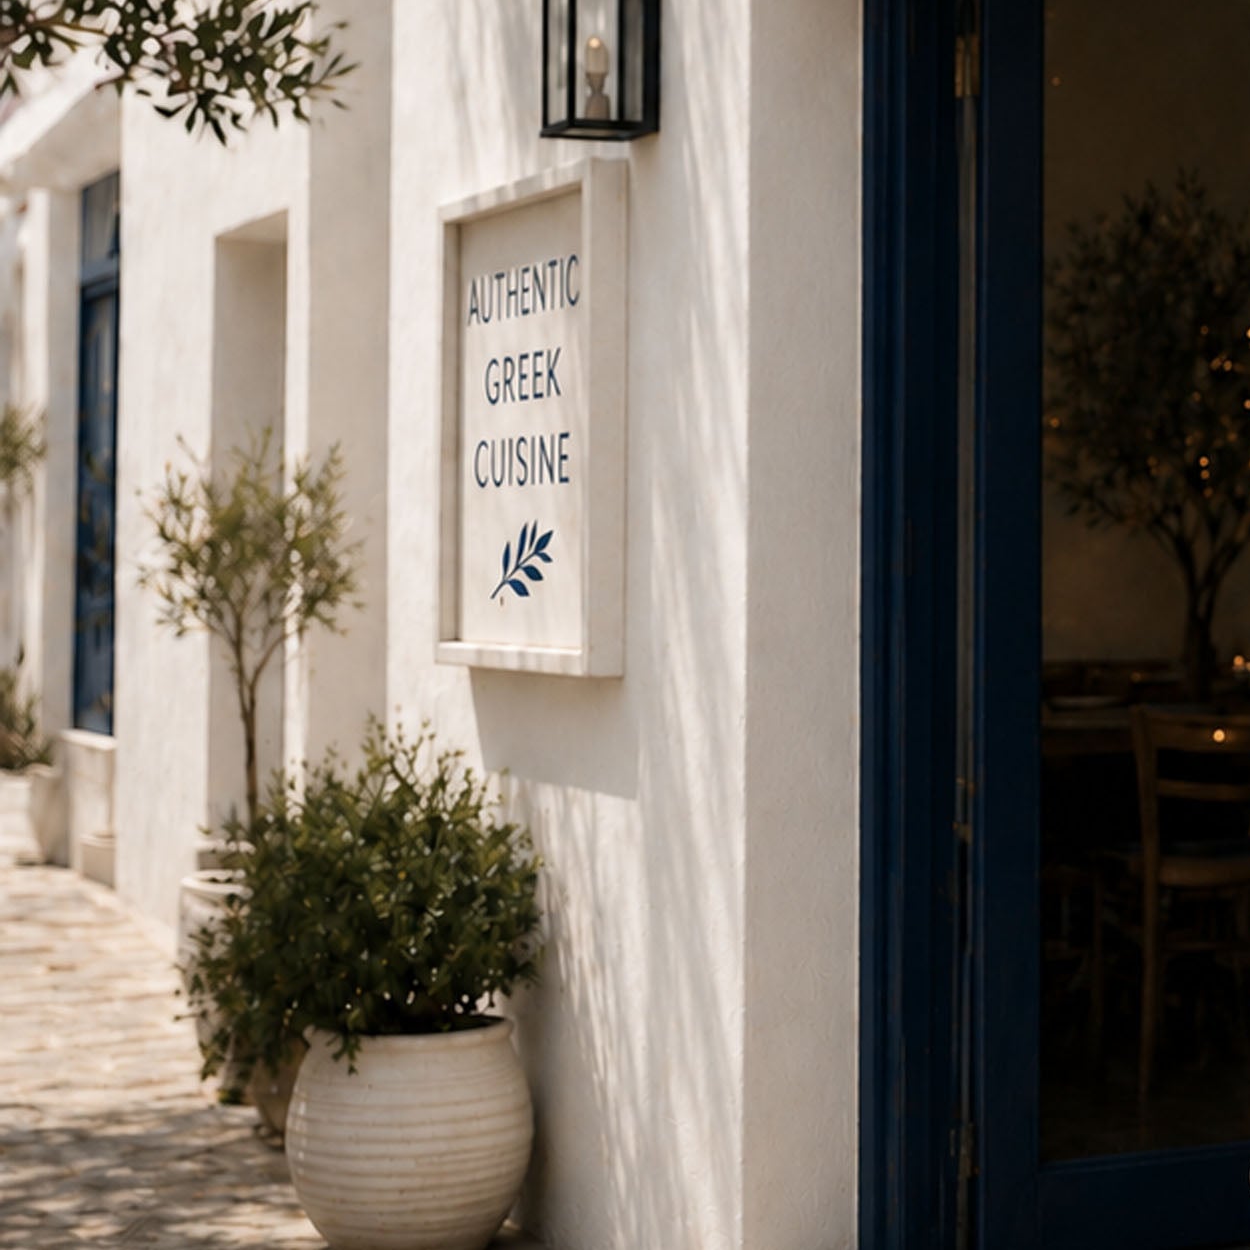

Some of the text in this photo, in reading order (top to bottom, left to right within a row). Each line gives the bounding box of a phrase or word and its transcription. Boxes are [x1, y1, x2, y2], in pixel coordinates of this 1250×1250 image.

[467, 253, 581, 327] AUTHENTIC
[484, 347, 562, 406] GREEK
[474, 431, 571, 489] CUISINE
